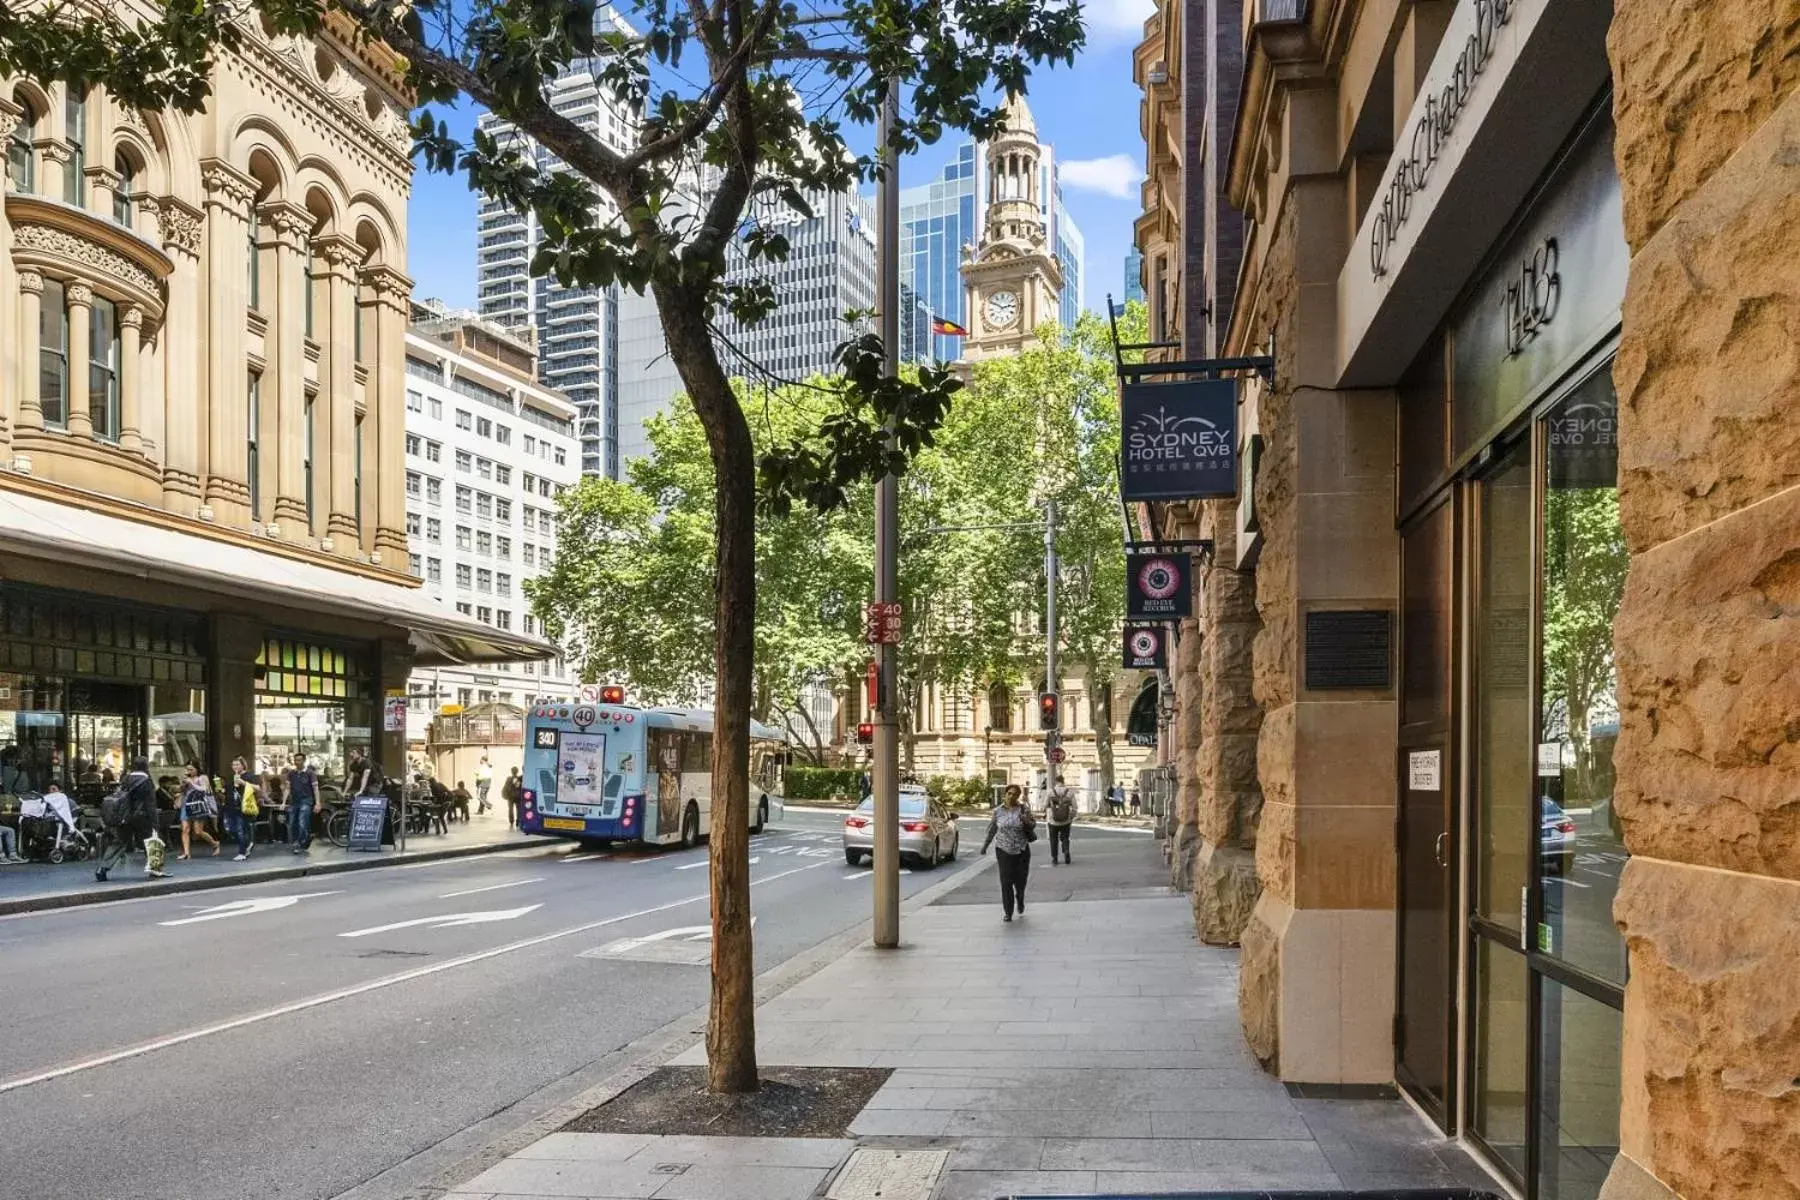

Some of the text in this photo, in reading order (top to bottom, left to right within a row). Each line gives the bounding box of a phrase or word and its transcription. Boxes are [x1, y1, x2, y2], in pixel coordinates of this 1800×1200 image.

[1130, 431, 1229, 448] SYDNEY
[1129, 444, 1231, 461] HOTEL QVB
[883, 604, 902, 614] 40
[886, 618, 901, 629] 30
[883, 631, 901, 642] 20
[575, 710, 593, 722] 40
[538, 731, 556, 746] 340
